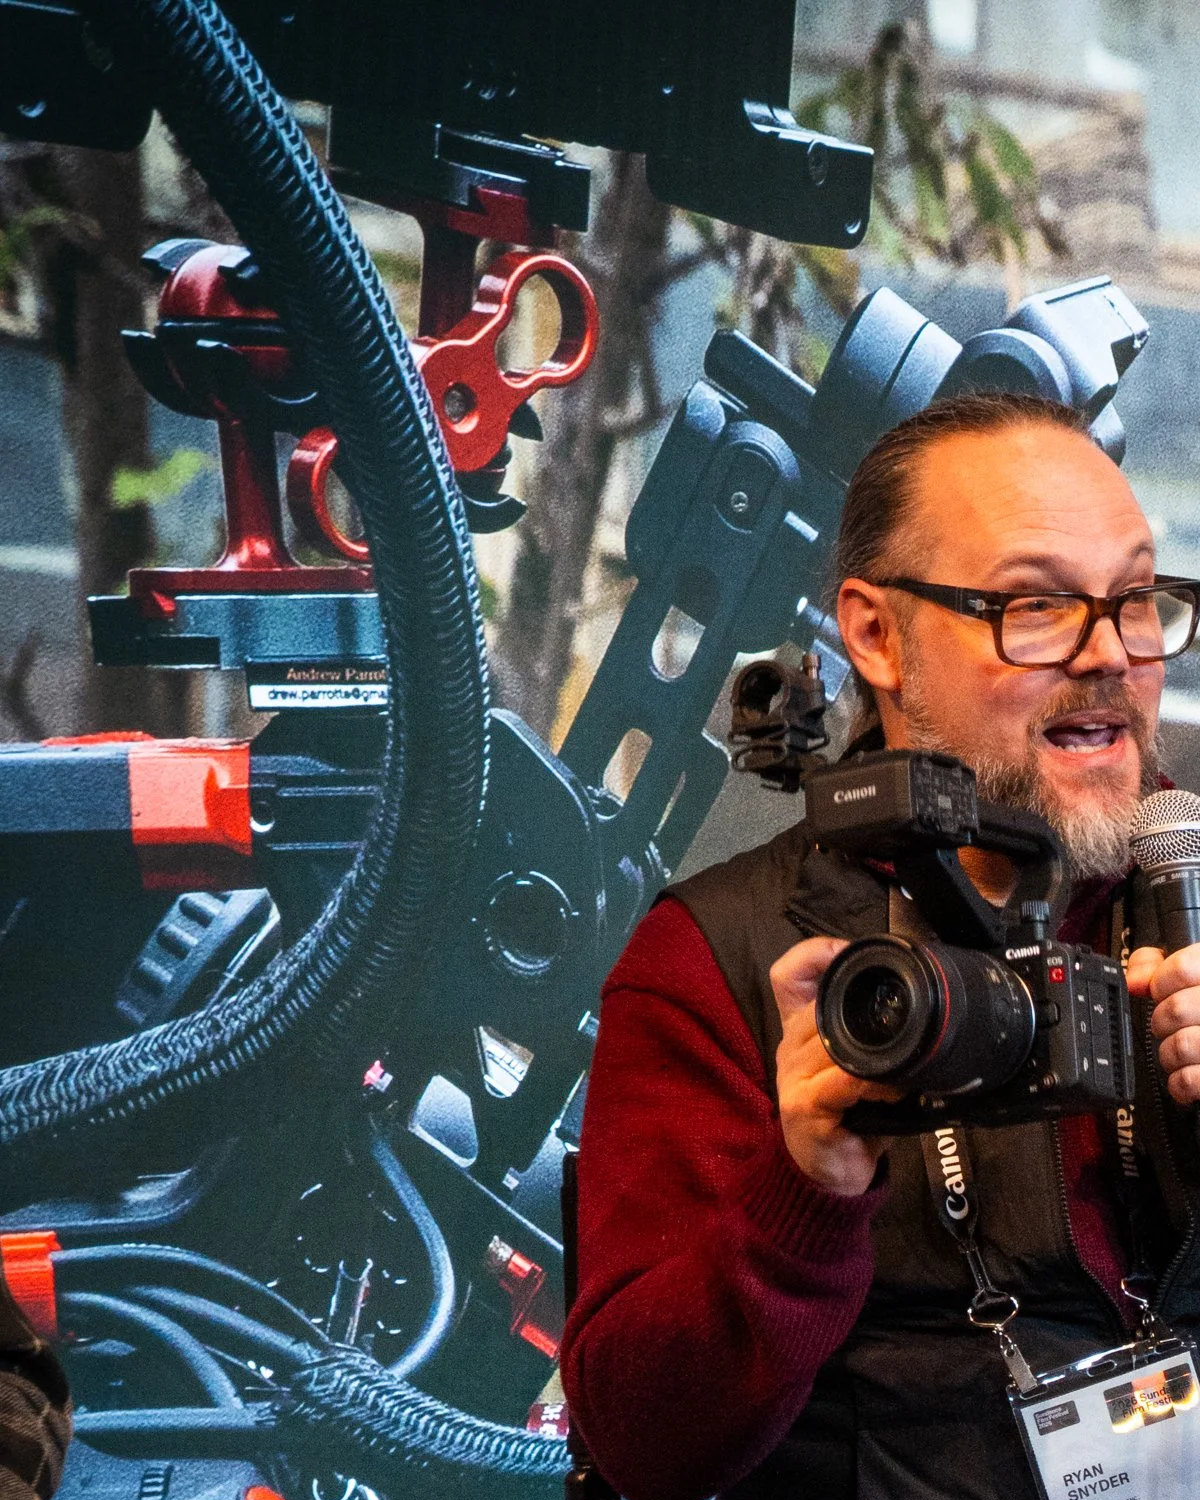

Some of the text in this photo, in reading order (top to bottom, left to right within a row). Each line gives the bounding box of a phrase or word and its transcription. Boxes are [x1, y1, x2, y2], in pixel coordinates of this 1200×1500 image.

[286, 667, 387, 681] Andrew Parrot
[833, 784, 877, 804] Canon
[1005, 945, 1041, 960] Canon
[1047, 956, 1063, 966] EOS
[1116, 1105, 1140, 1178] anon
[1062, 1463, 1104, 1487] RYAN
